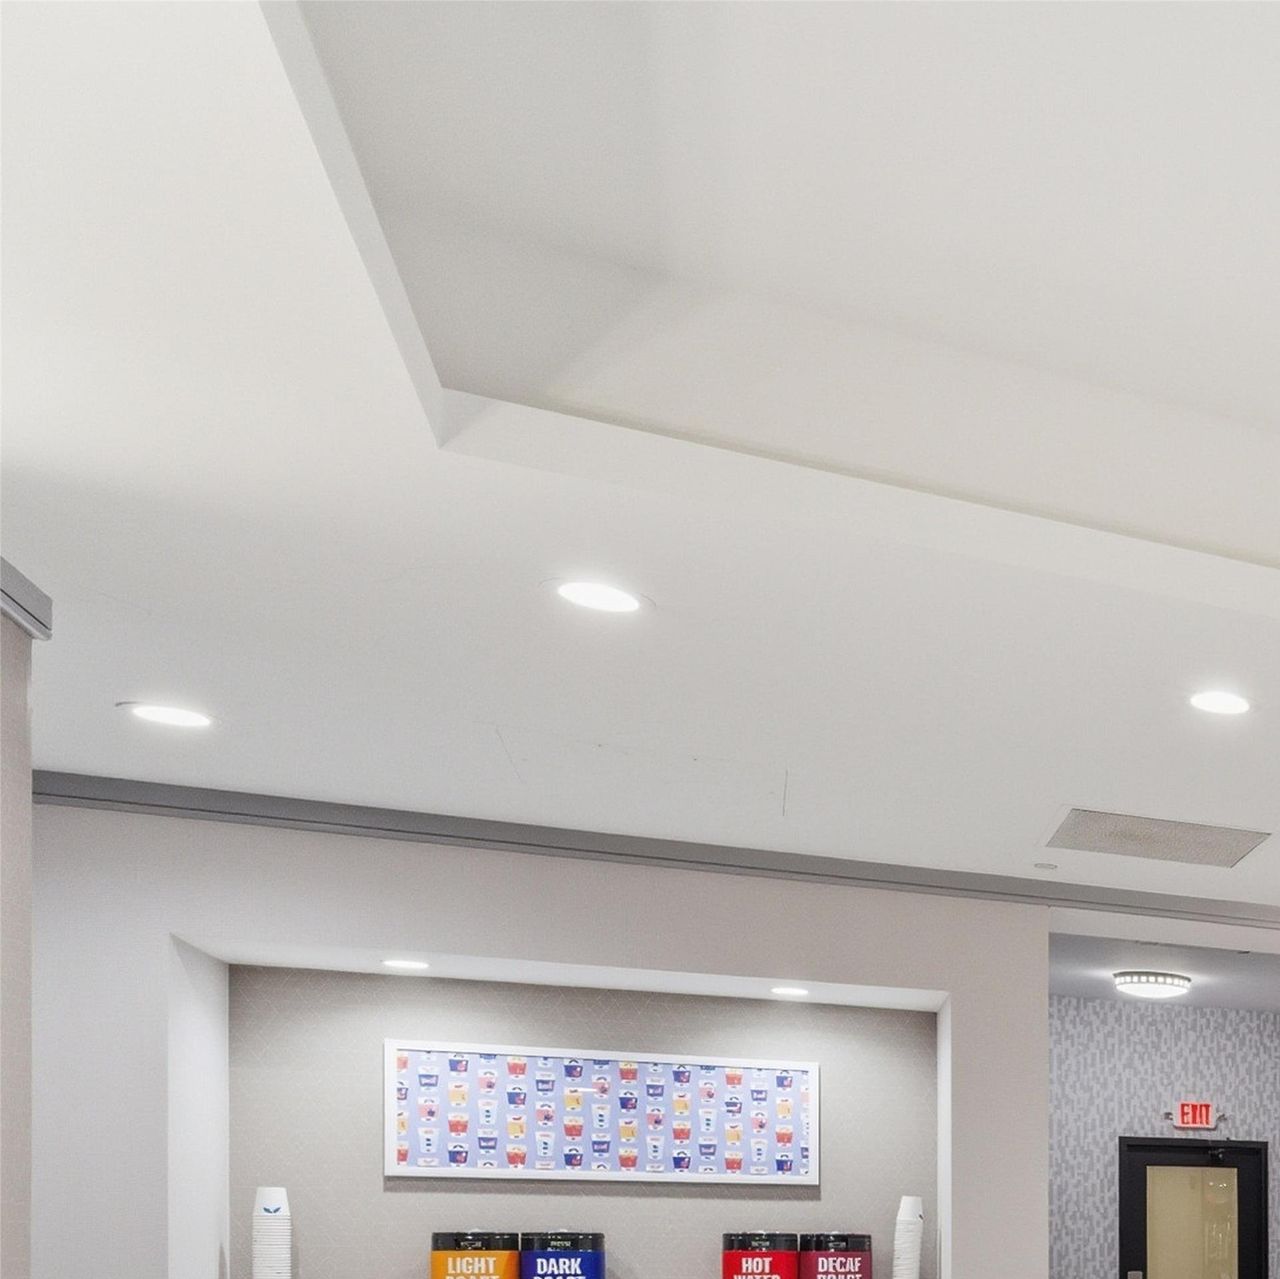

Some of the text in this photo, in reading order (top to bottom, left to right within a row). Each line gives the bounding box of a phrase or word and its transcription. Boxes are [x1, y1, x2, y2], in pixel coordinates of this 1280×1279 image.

[1180, 1103, 1211, 1125] EXIT
[447, 1256, 497, 1274] LIGHT
[536, 1257, 582, 1275] DARK
[741, 1257, 773, 1273] HOT
[817, 1257, 862, 1273] DECAF
